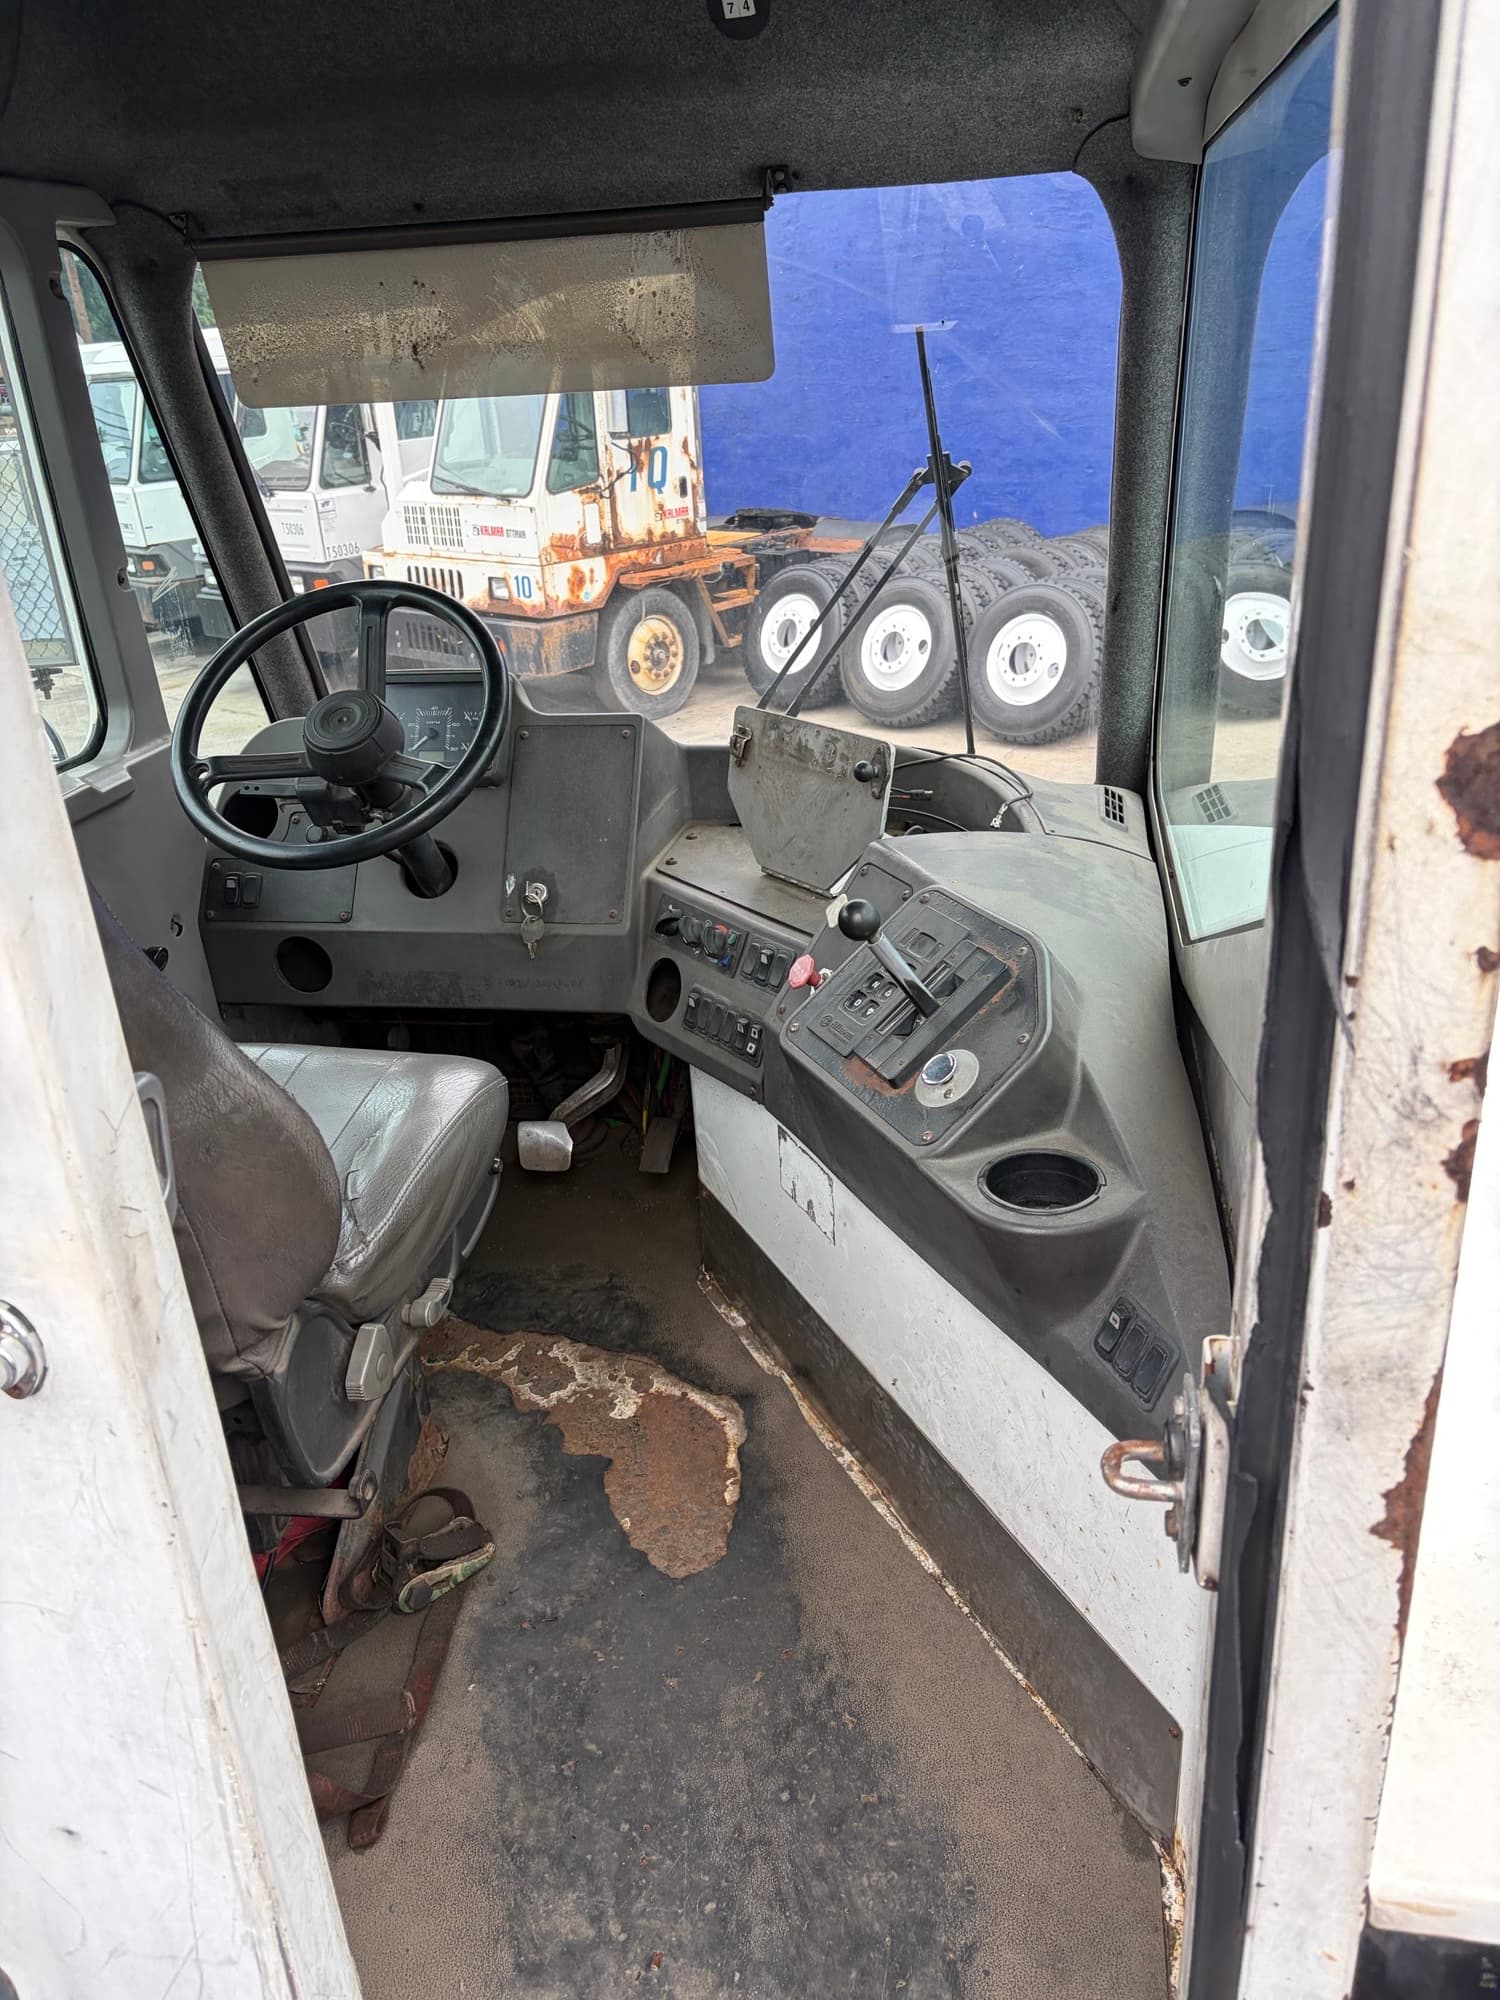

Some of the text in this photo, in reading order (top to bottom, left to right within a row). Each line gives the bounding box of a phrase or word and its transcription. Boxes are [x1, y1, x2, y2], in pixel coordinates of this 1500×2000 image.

[480, 525, 505, 537] KALMAR
[326, 541, 361, 559] T50306
[513, 575, 533, 599] 10
